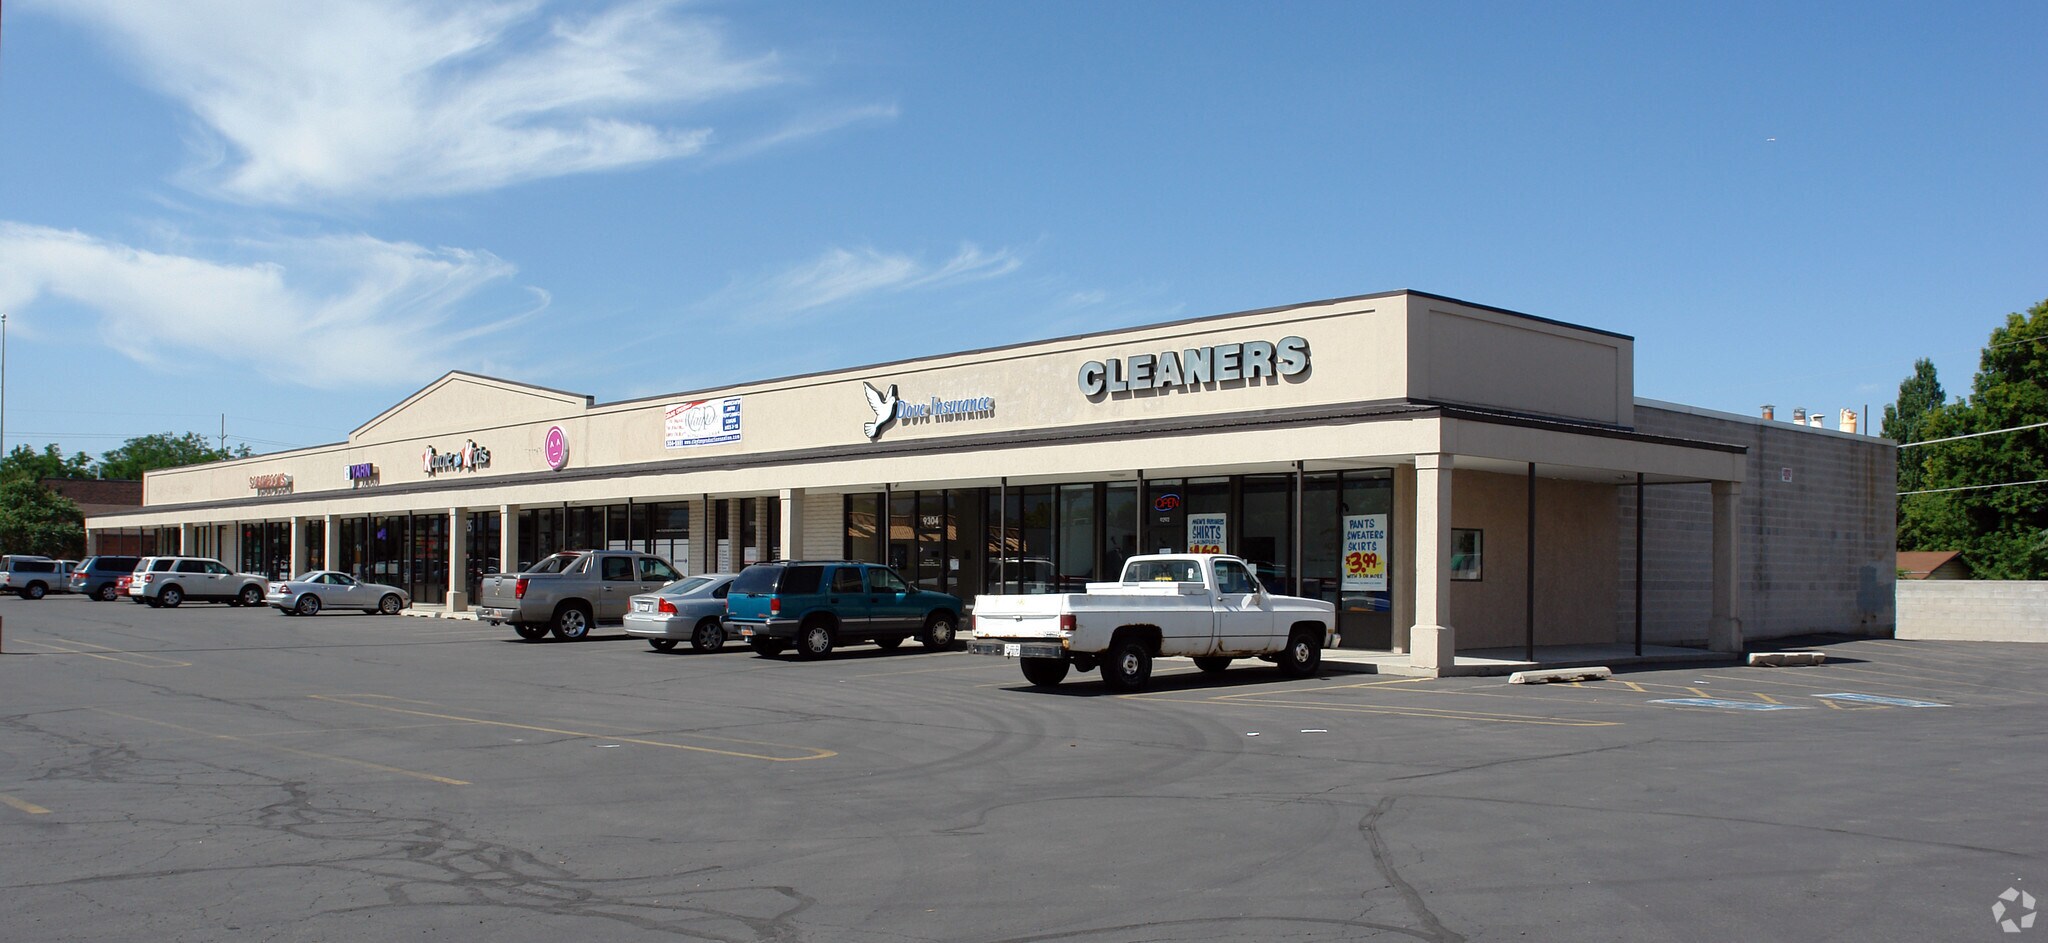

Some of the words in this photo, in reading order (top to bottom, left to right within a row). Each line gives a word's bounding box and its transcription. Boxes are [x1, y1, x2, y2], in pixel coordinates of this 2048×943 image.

[1078, 335, 1311, 400] CLEANERS
[896, 399, 929, 420] Dove
[931, 396, 995, 416] Insurance
[462, 439, 491, 468] Kids
[350, 463, 373, 480] YARN
[1155, 497, 1180, 509] OPEN
[923, 516, 939, 525] 9304
[1349, 519, 1375, 529] PANTS
[1192, 525, 1222, 539] SHIRTS
[1347, 530, 1384, 540] SWEATERS
[1348, 541, 1378, 551] SKIRTS
[1345, 551, 1377, 573] $3.99
